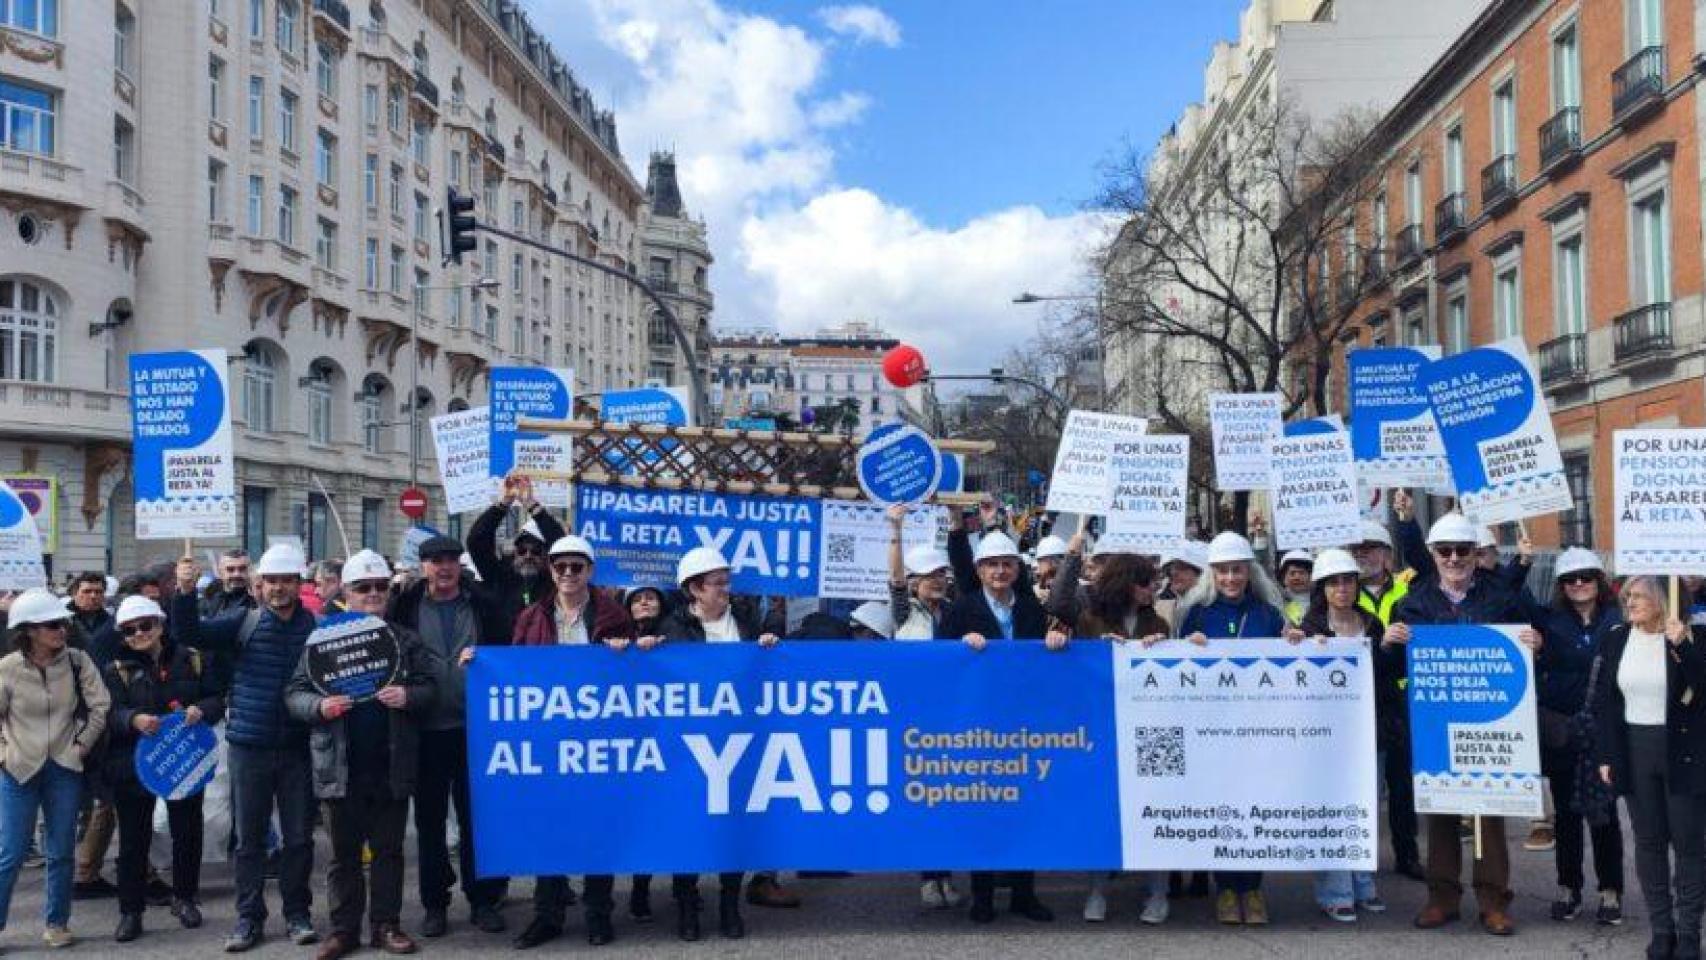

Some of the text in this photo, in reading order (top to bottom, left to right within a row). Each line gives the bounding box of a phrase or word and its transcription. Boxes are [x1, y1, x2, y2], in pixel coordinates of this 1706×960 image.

[135, 366, 207, 382] LA MUTUA Y
[135, 381, 199, 395] EL ESTADO
[1428, 372, 1480, 394] NO A LA
[137, 395, 194, 409] NOS HAN
[1436, 386, 1524, 416] CON NUESTRA
[137, 410, 185, 423] DEJADO
[138, 424, 191, 436] TIRADOS
[1103, 420, 1139, 432] UNAS
[1113, 443, 1182, 455] POR UNAS
[1272, 438, 1345, 456] POR UNAS
[1623, 439, 1662, 453] POR
[1111, 456, 1184, 469] PENSIONES
[1271, 452, 1349, 469] PENSIONES
[1487, 449, 1538, 467] JUSTA AL
[168, 466, 216, 479] JUSTA AL
[1488, 465, 1517, 478] RETA
[168, 480, 192, 490] RETA
[1111, 500, 1182, 512] AL RETA YA!
[1277, 493, 1353, 511] AL RETA YA!
[1624, 490, 1706, 509] ¡PASARE
[735, 499, 812, 523] JUSTA
[1620, 508, 1644, 522] AL
[1648, 507, 1694, 521] RETA
[580, 520, 613, 542] AL
[620, 523, 682, 546] RETA
[692, 525, 811, 579] YA!!
[1413, 647, 1507, 660] ESTA MUTUA
[1414, 661, 1514, 674] ALTERNATIVA
[1414, 676, 1490, 688] NOS DEJA
[488, 680, 890, 723] ¡¡PASARELA JUSTA
[1414, 690, 1509, 702] A LA DERIVA
[904, 727, 1095, 752] Constitucional,
[1196, 726, 1333, 740] www.anmarq.com
[1453, 729, 1524, 742] ¡PASARELA
[1455, 743, 1515, 755] JUSTA AL
[904, 753, 1052, 781] Universal y
[1455, 755, 1512, 766] RETA YA!
[486, 727, 891, 816] AL RETA YA!!
[904, 781, 1020, 806] Optativa
[1142, 804, 1369, 822] Arquitect@s, Aparejador@s
[1153, 824, 1370, 842] Abogad@s, Procurador@s
[1213, 844, 1372, 860] Mutualist@s tod@s
